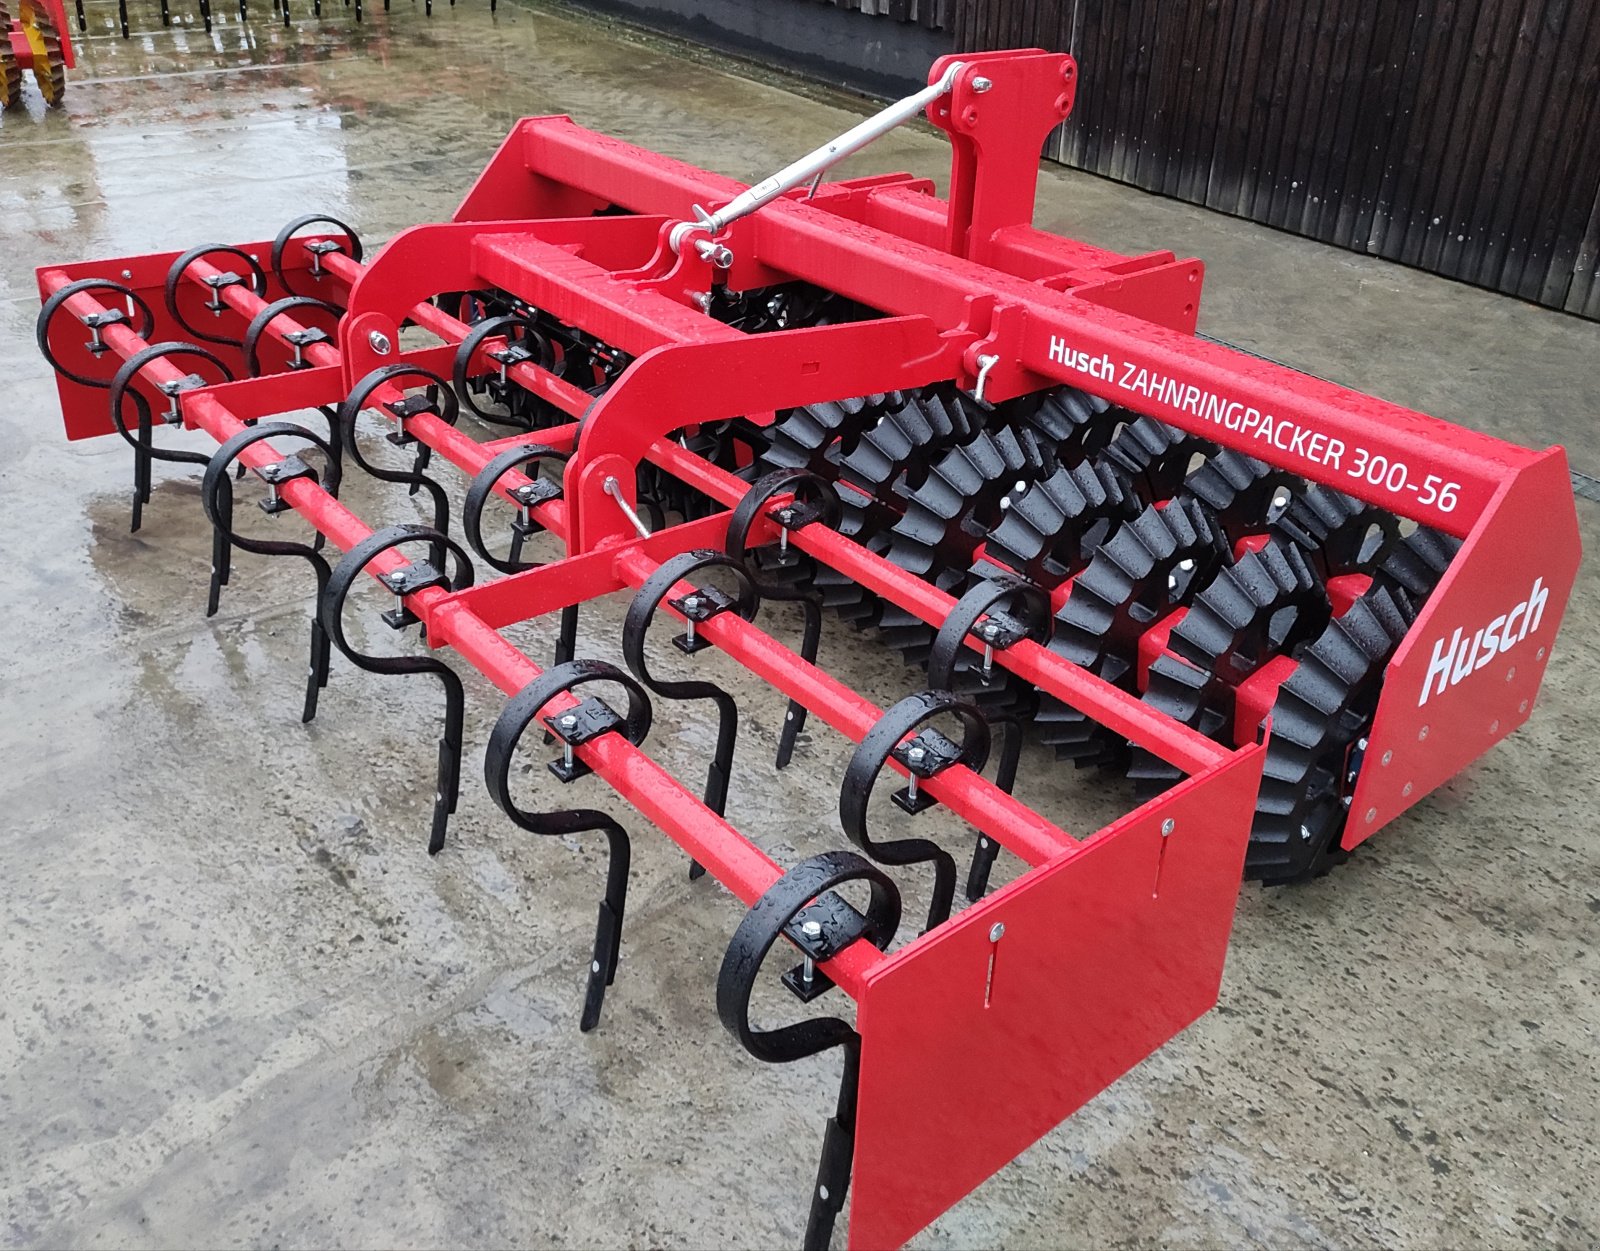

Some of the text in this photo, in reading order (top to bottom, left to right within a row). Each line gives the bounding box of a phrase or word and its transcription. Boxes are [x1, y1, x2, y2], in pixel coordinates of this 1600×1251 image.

[1048, 335, 1461, 513] Husch ZAHNRINGPACKER 300-56
[1418, 576, 1549, 707] Husch
